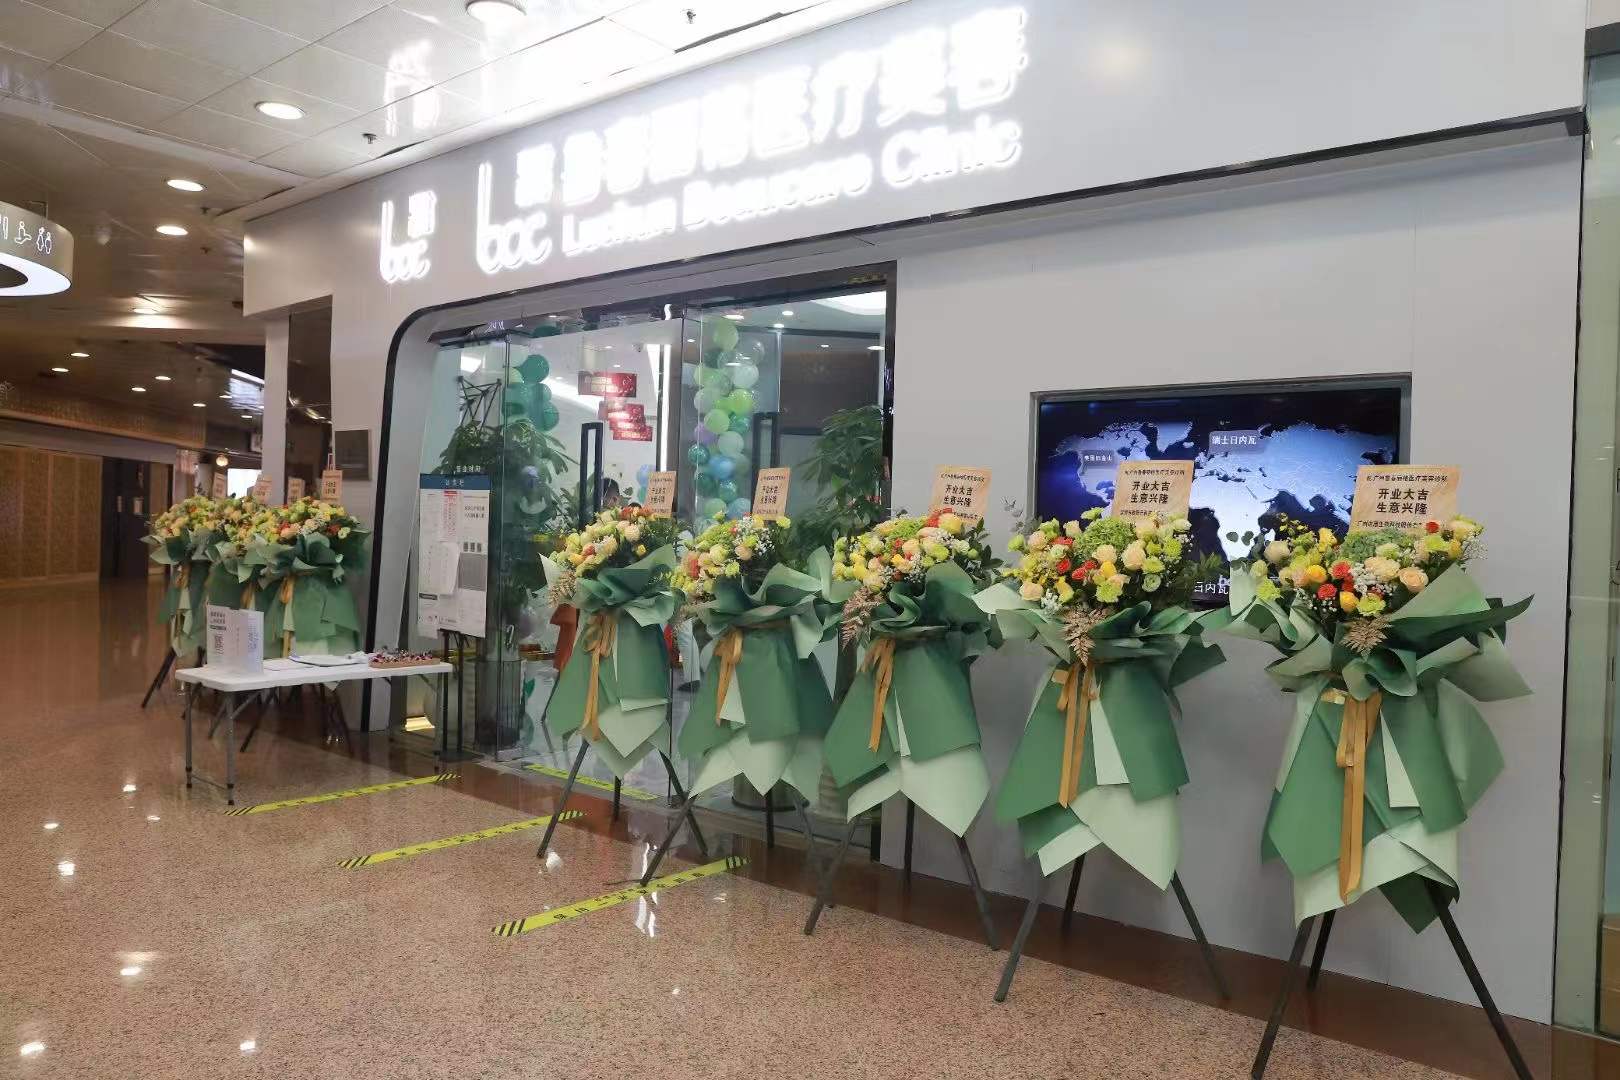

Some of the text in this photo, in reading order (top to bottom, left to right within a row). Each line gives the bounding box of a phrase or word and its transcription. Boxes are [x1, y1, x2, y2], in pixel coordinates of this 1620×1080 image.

[1211, 435, 1257, 445] 瑞士日内瓦
[944, 484, 973, 496] 开业大吉
[1132, 481, 1171, 492] 开业大吉
[1130, 493, 1169, 504] 生意兴隆
[1378, 488, 1429, 501] 开业大吉
[1376, 502, 1428, 515] 生意兴隆
